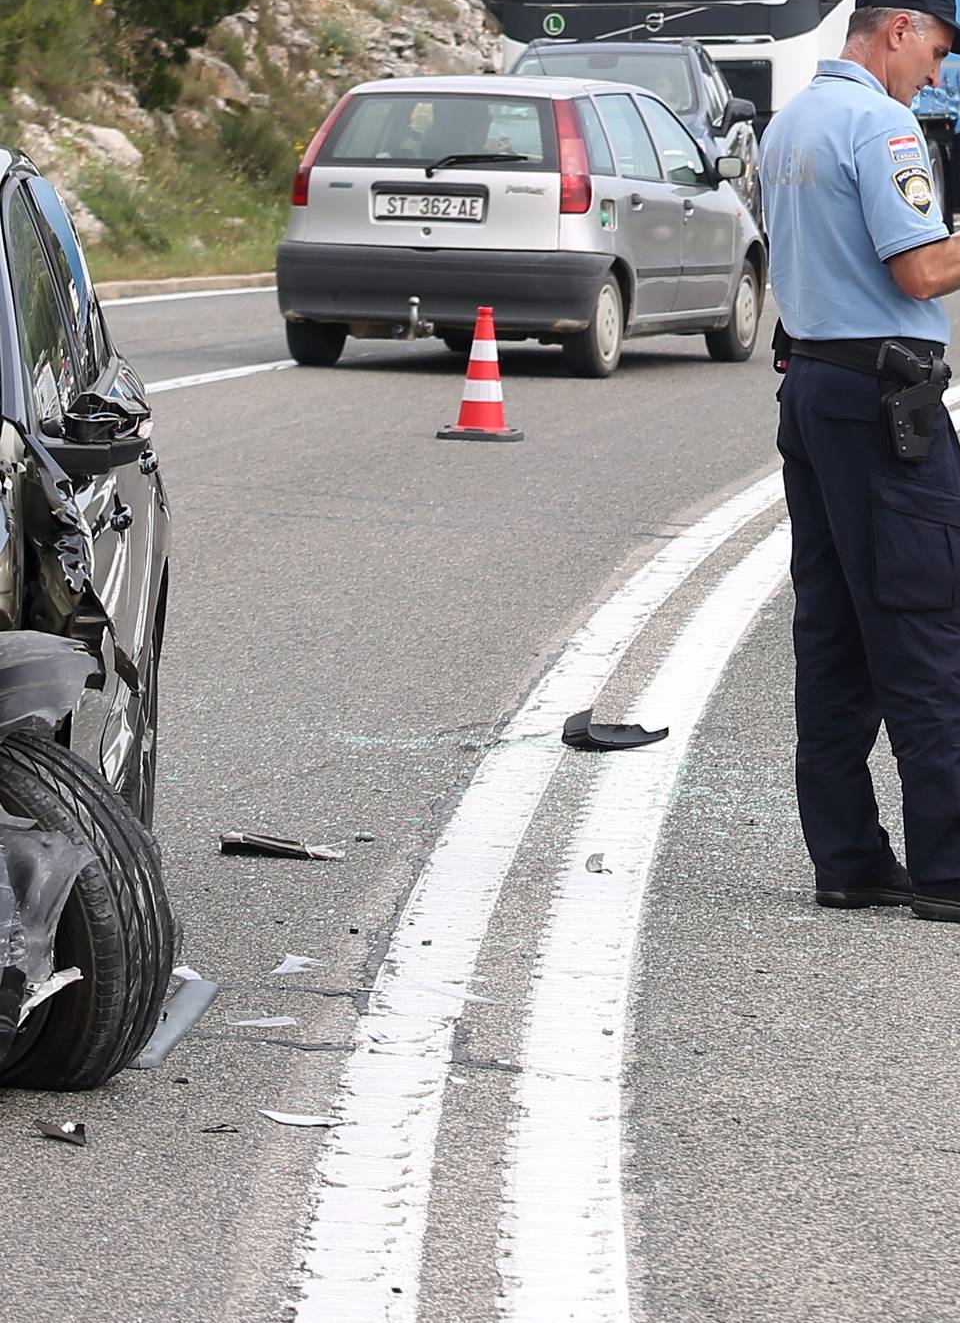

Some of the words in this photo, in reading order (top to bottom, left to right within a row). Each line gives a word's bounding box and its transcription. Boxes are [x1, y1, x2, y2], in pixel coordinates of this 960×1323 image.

[549, 18, 559, 31] L
[387, 196, 406, 214] ST
[419, 197, 480, 217] 362-AE
